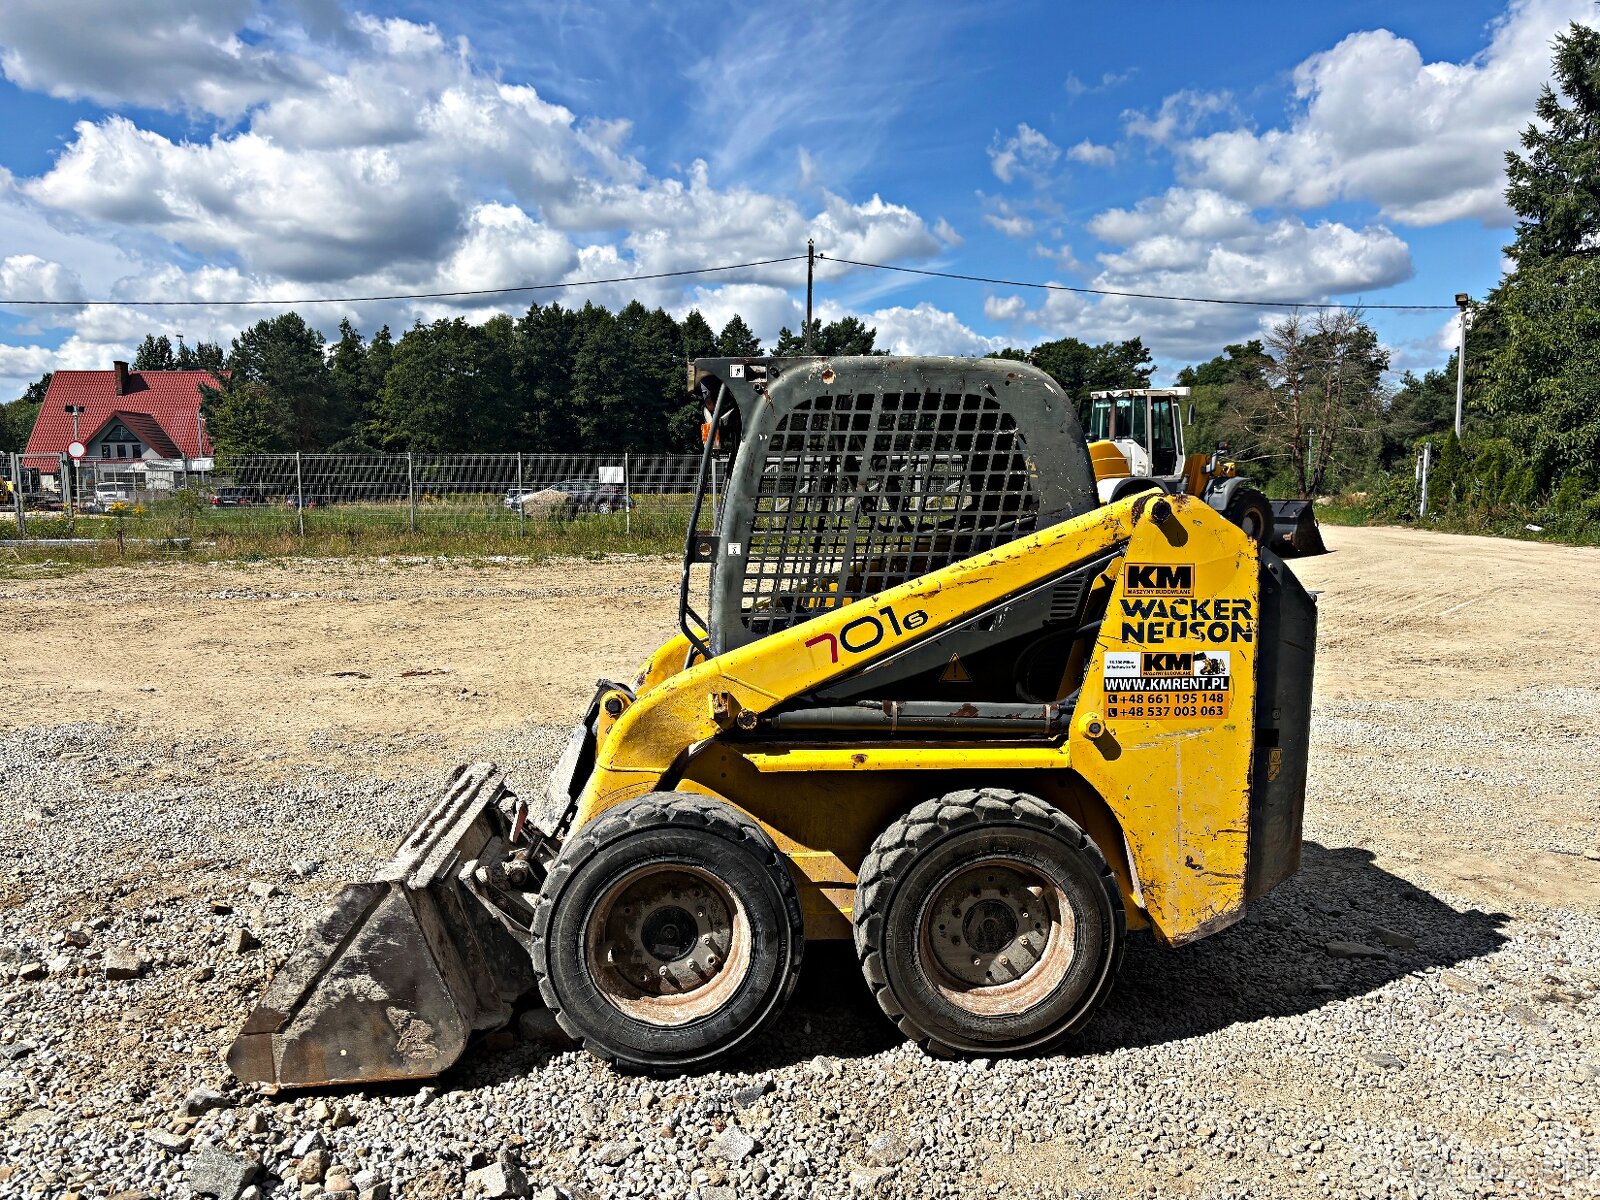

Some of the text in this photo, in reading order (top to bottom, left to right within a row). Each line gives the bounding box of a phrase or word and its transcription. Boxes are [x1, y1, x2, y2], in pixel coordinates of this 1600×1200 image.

[1127, 566, 1191, 589] KM
[1119, 598, 1253, 621] WACKER
[1122, 622, 1253, 643] NEUSON
[1143, 653, 1192, 671] KM
[1105, 677, 1228, 691] WWW.KMRENT.PL
[1120, 693, 1224, 704] +48 661 195 148
[1120, 706, 1224, 717] +48 537 003 063
